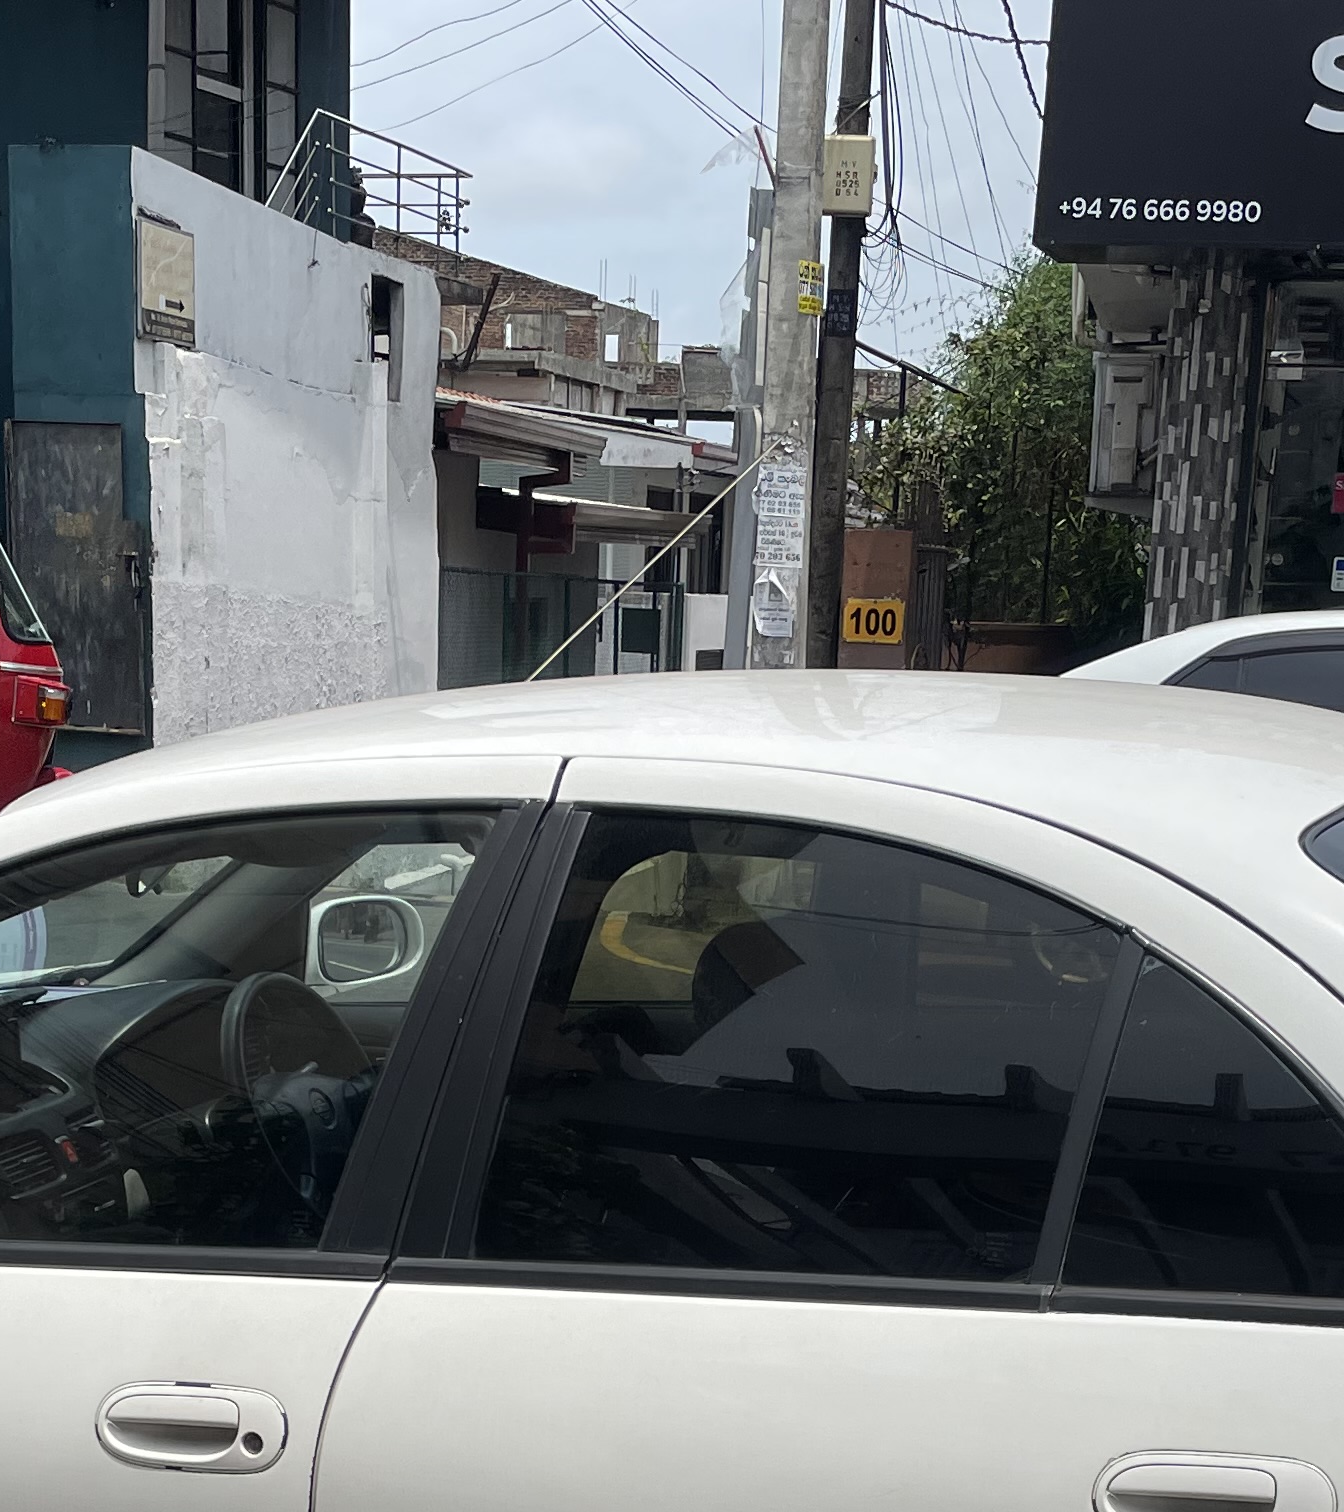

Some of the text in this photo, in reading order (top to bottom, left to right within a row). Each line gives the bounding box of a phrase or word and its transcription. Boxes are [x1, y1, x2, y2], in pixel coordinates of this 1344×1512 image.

[1059, 197, 1262, 223] +94 76 666 9980
[850, 607, 896, 637] 100
